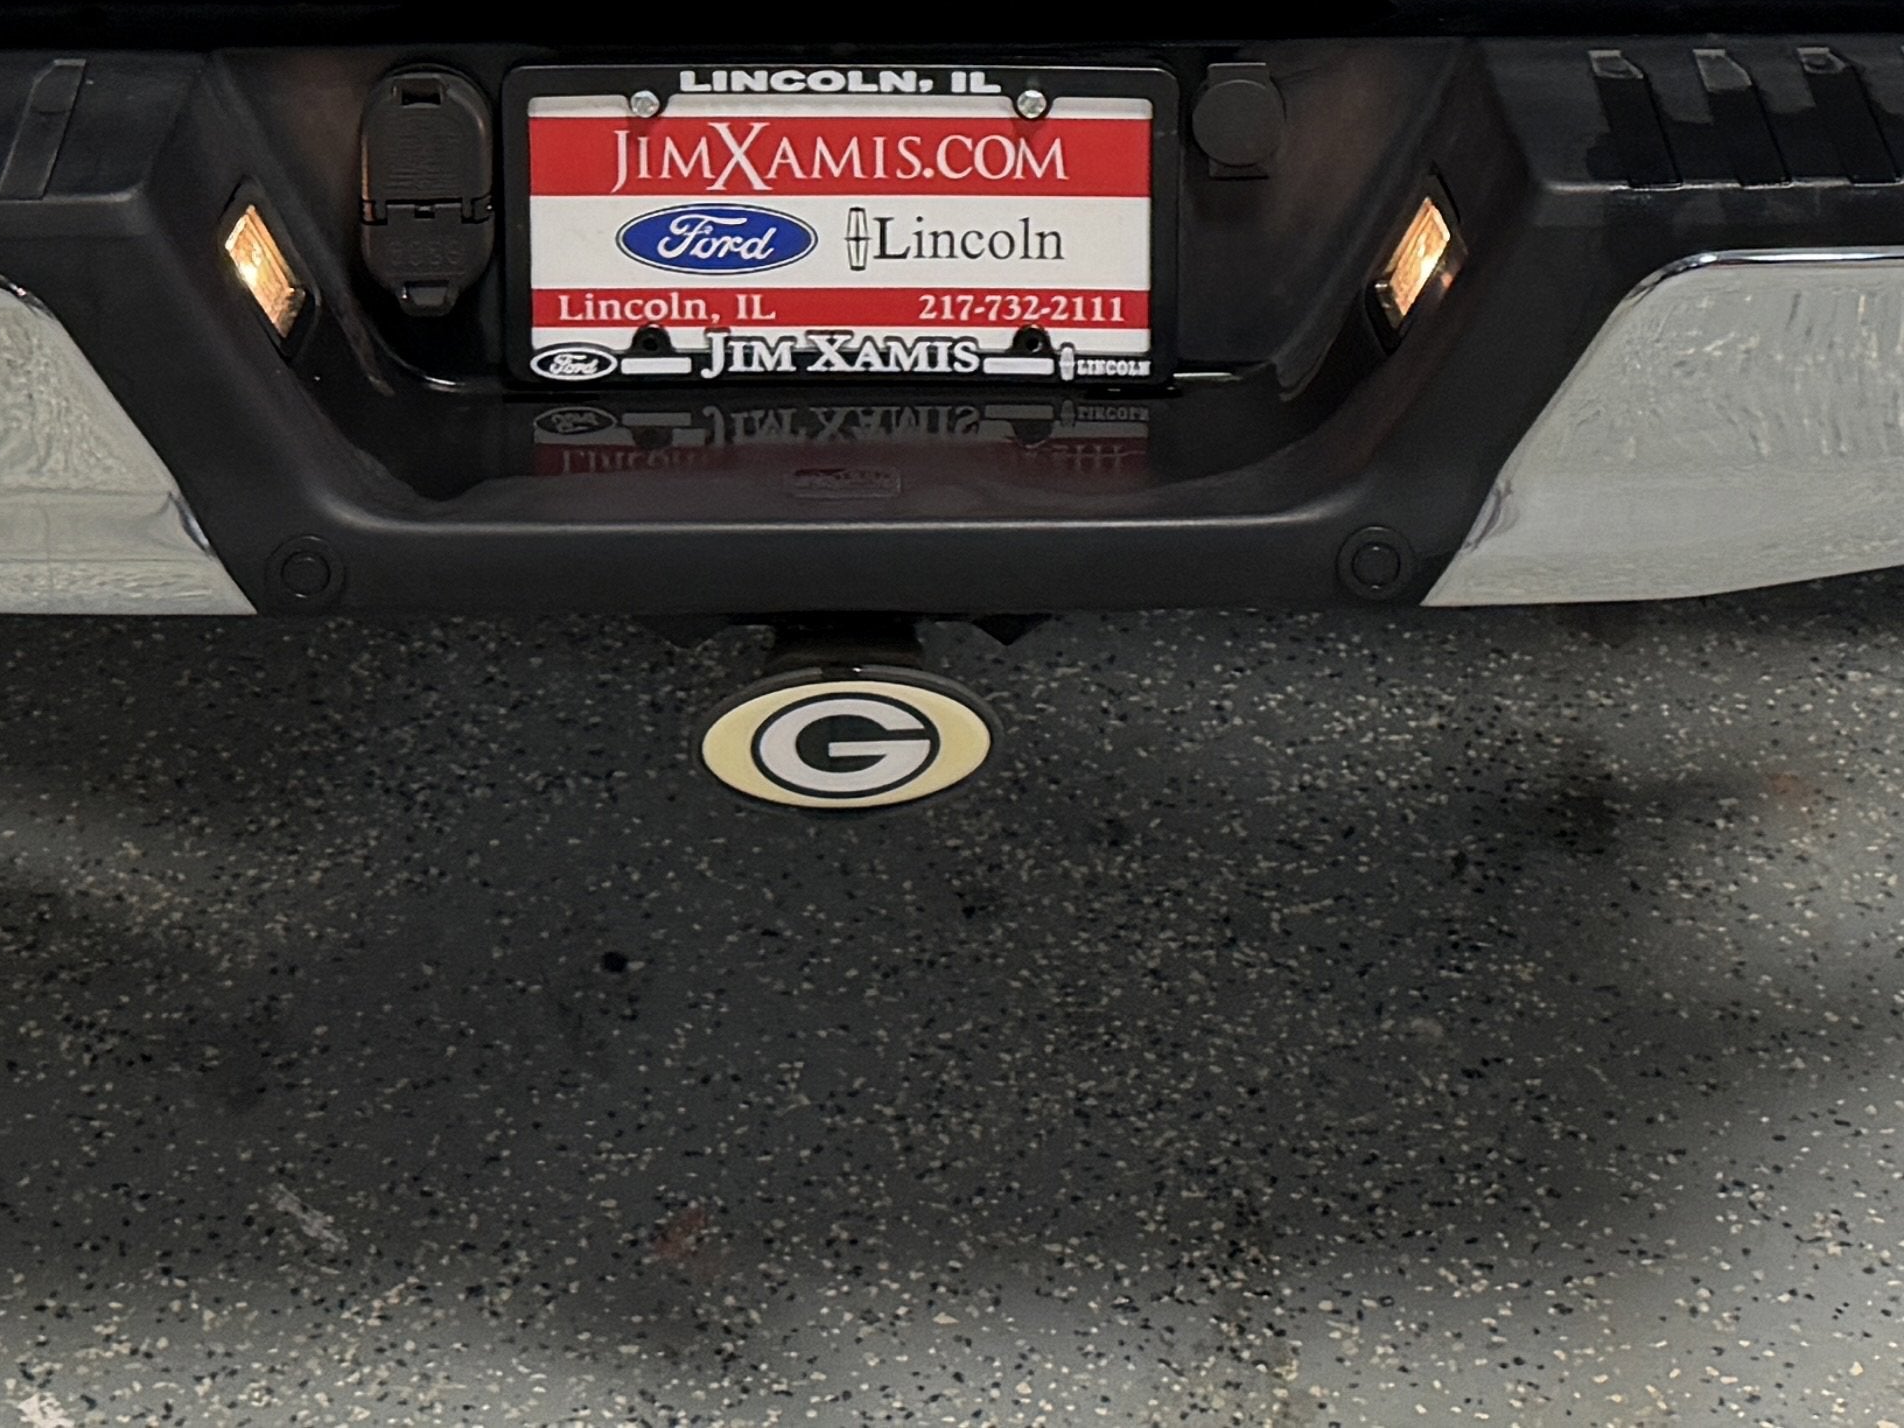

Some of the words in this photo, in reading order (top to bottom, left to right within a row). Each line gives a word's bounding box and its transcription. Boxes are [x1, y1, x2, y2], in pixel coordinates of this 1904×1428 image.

[679, 71, 935, 94] LINCOLN,
[951, 72, 1001, 94] IL
[656, 214, 774, 261] Ford
[873, 217, 1065, 261] Lincoln
[558, 293, 720, 325] Lincoln,
[736, 294, 776, 321] IL
[918, 295, 1125, 322] 217-732-2111
[549, 352, 599, 377] Ford
[701, 331, 796, 379] JIM
[806, 332, 980, 373] XAMIS
[1076, 360, 1151, 378] LINCOLN
